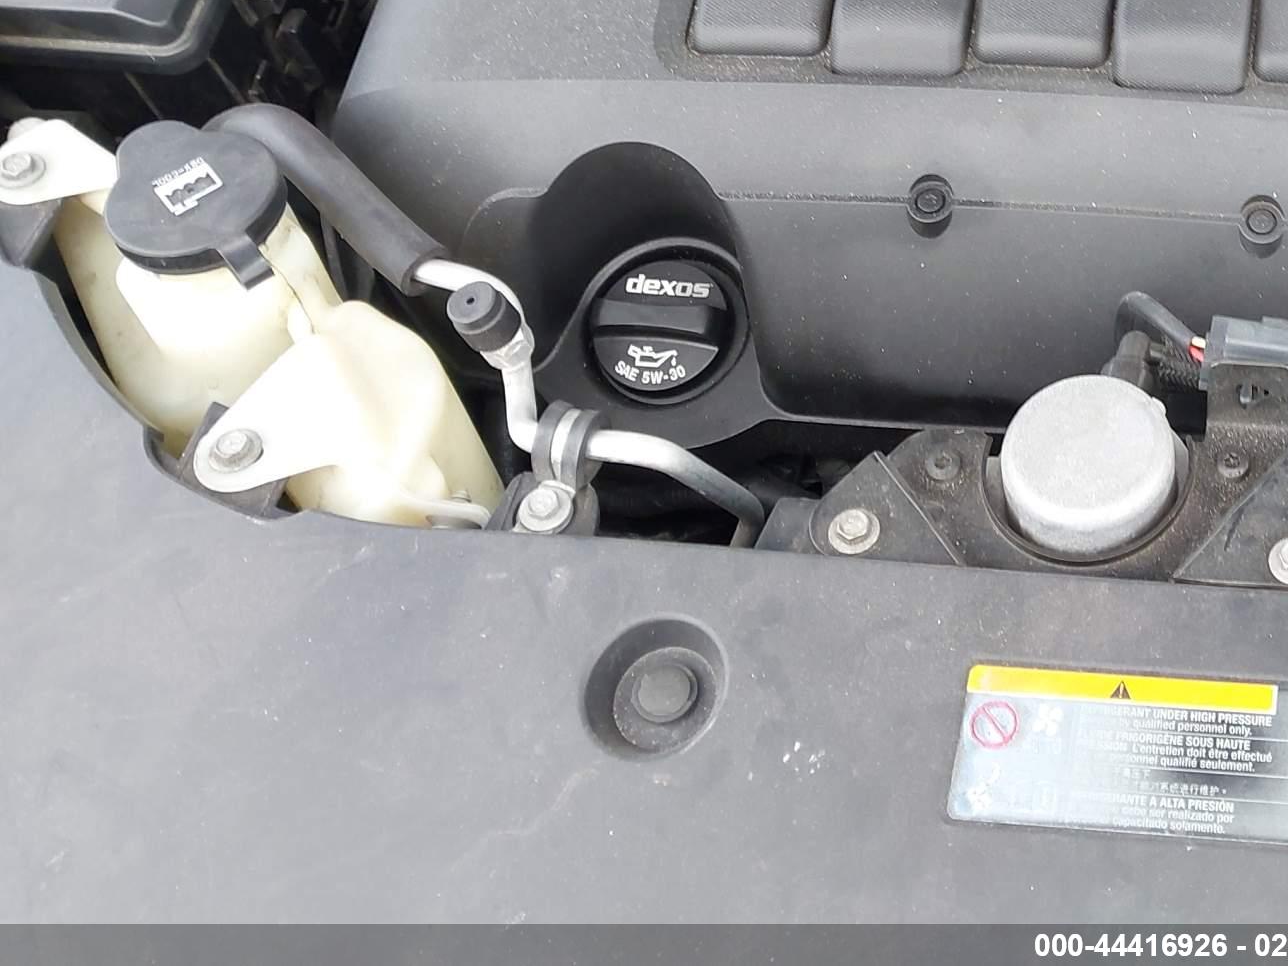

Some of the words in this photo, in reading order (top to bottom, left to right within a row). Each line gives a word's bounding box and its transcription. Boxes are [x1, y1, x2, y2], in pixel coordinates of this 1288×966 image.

[625, 274, 712, 298] dexos
[614, 360, 641, 382] SAE
[641, 365, 687, 385] 5W-30
[1153, 710, 1188, 721] UNDER
[1190, 712, 1216, 723] HIGH
[1217, 714, 1273, 727] PRESSURE
[1133, 719, 1175, 731] qualified
[1177, 722, 1227, 734] personnel
[1228, 726, 1252, 737] only.
[1186, 736, 1213, 747] SOUS
[1216, 738, 1251, 751] HAUTE
[1187, 746, 1206, 758] doit
[1208, 748, 1228, 759] être
[1231, 750, 1273, 763] effectué
[1160, 756, 1197, 768] qualifié
[1200, 759, 1255, 772] seulement.
[1149, 797, 1157, 806] A
[1160, 798, 1186, 810] ALTA
[1188, 799, 1234, 813] PRESIÓN
[1167, 809, 1214, 822] realizado
[1216, 814, 1234, 825] por
[1170, 820, 1226, 835] solamente.
